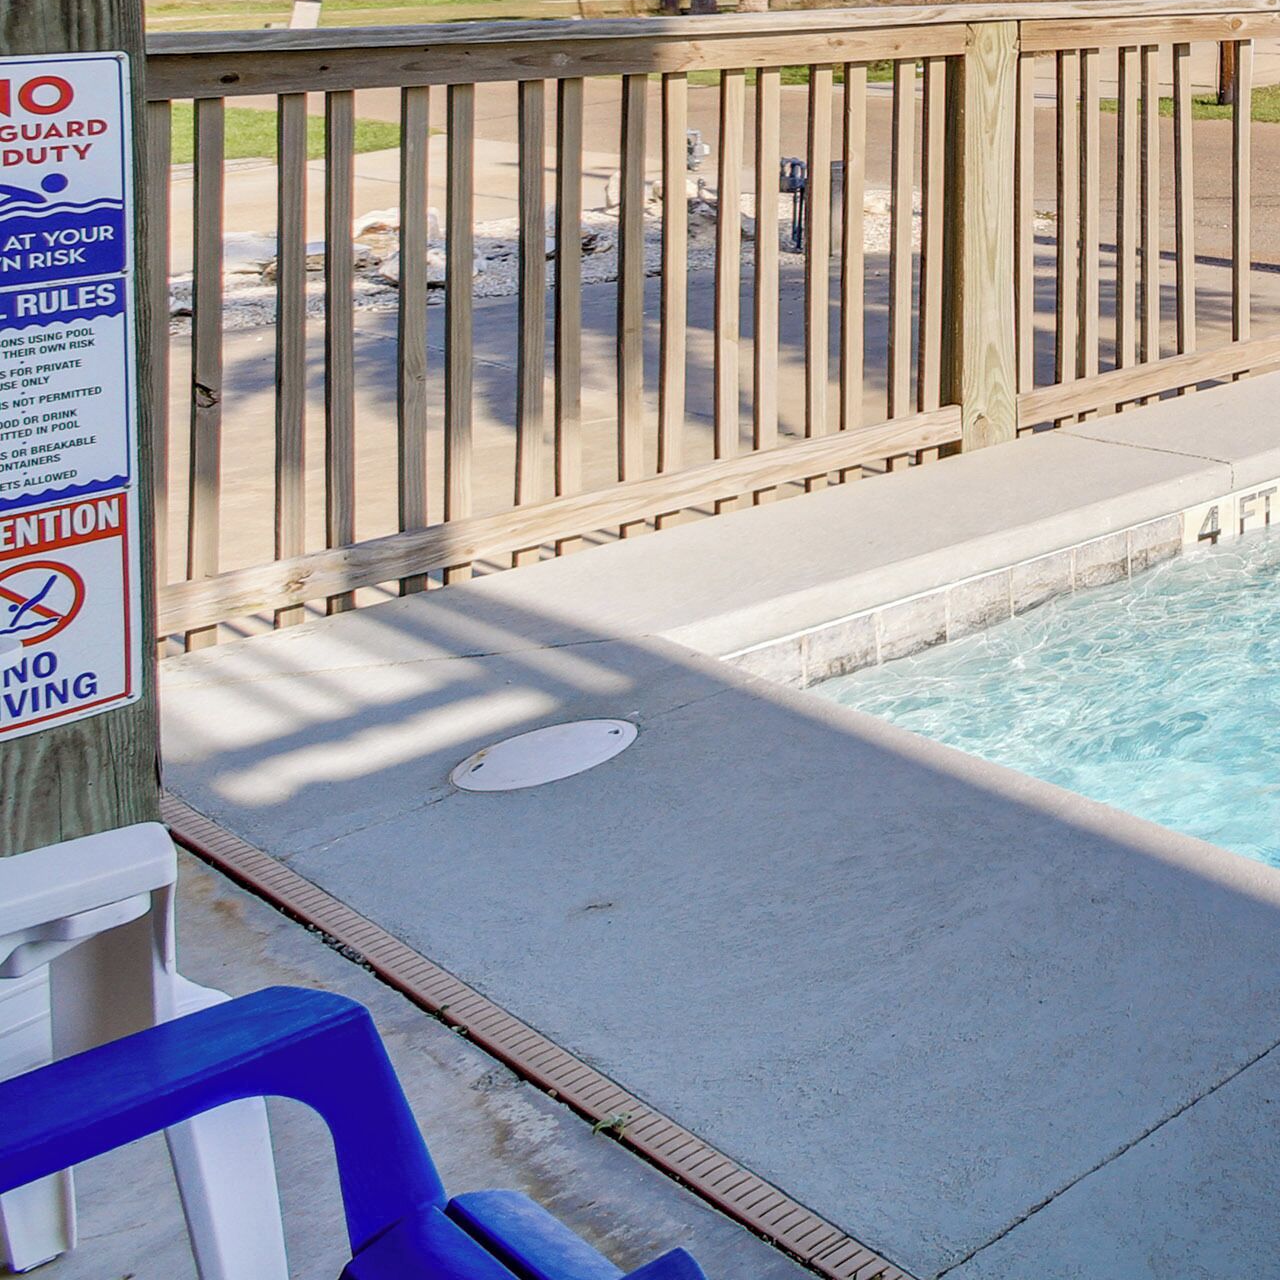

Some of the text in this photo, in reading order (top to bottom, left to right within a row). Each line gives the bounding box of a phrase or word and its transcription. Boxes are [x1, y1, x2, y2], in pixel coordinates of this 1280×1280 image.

[0, 119, 108, 142] GUARD
[3, 143, 93, 166] DUTY
[3, 225, 114, 252] AT YOUR
[0, 247, 87, 272] N RISK
[16, 283, 116, 317] RULES
[0, 328, 95, 348] ONS USING POOL
[2, 338, 96, 359] THEIR OWN RISK
[10, 367, 33, 377] FOR
[36, 359, 82, 373] PRIVATE
[21, 376, 50, 387] ONLY
[0, 386, 102, 410] S NOT PERMITTED
[23, 415, 39, 425] OR
[43, 409, 78, 422] DRINK
[37, 425, 48, 434] IN
[51, 420, 80, 432] POOL
[11, 449, 27, 458] OR
[31, 435, 97, 455] BREAKABLE
[24, 470, 77, 487] ALLOWED
[0, 498, 119, 552] ENTION
[1198, 486, 1277, 545] 4 FT
[3, 651, 58, 688] NO
[0, 672, 97, 719] VING
